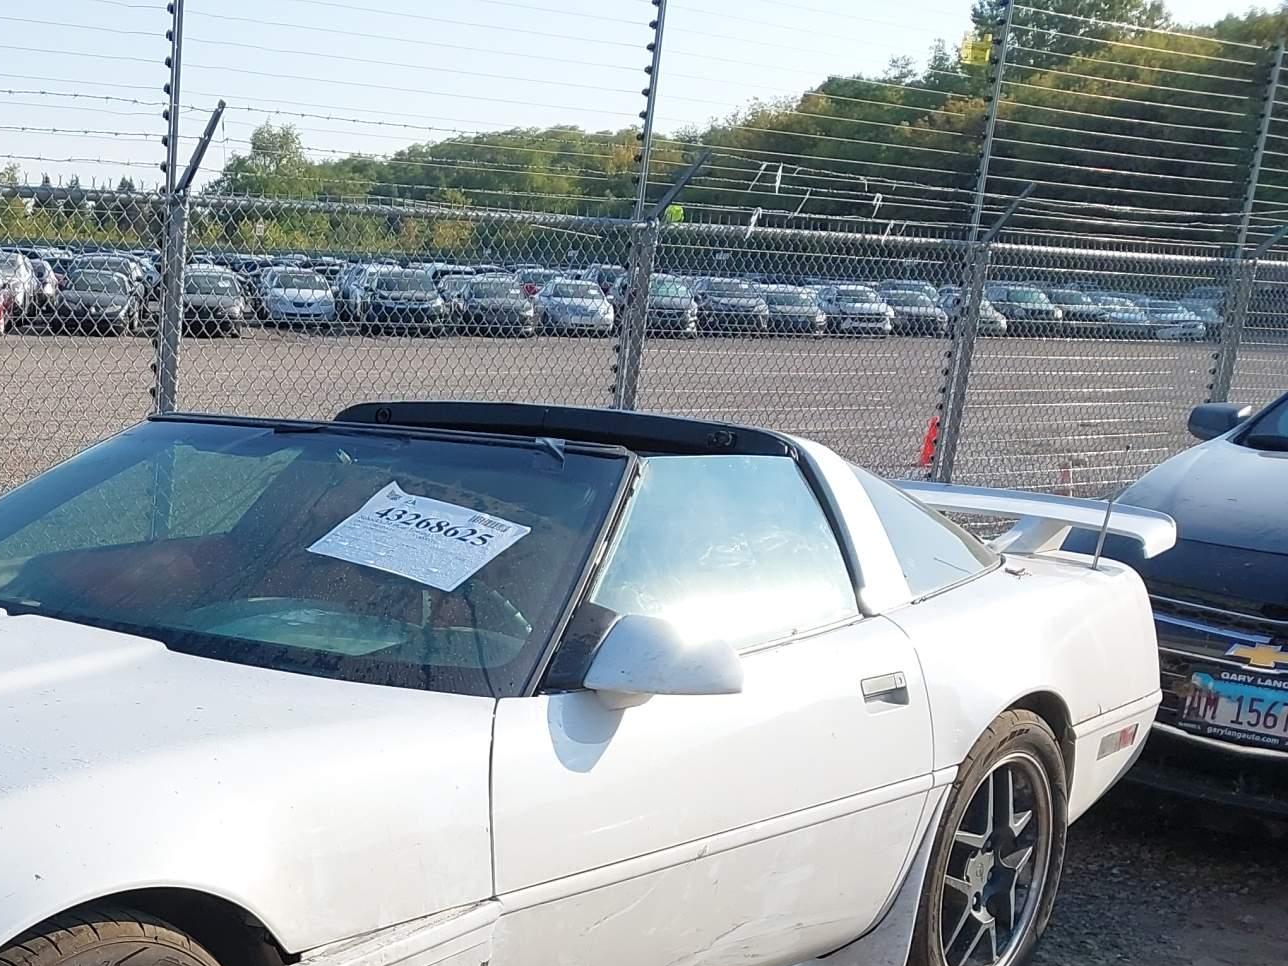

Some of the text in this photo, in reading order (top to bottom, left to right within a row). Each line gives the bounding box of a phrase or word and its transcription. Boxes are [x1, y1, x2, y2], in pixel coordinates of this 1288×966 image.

[375, 507, 494, 546] 43268625
[1220, 671, 1255, 683] GARY
[1207, 726, 1280, 744] garylangauto.com
